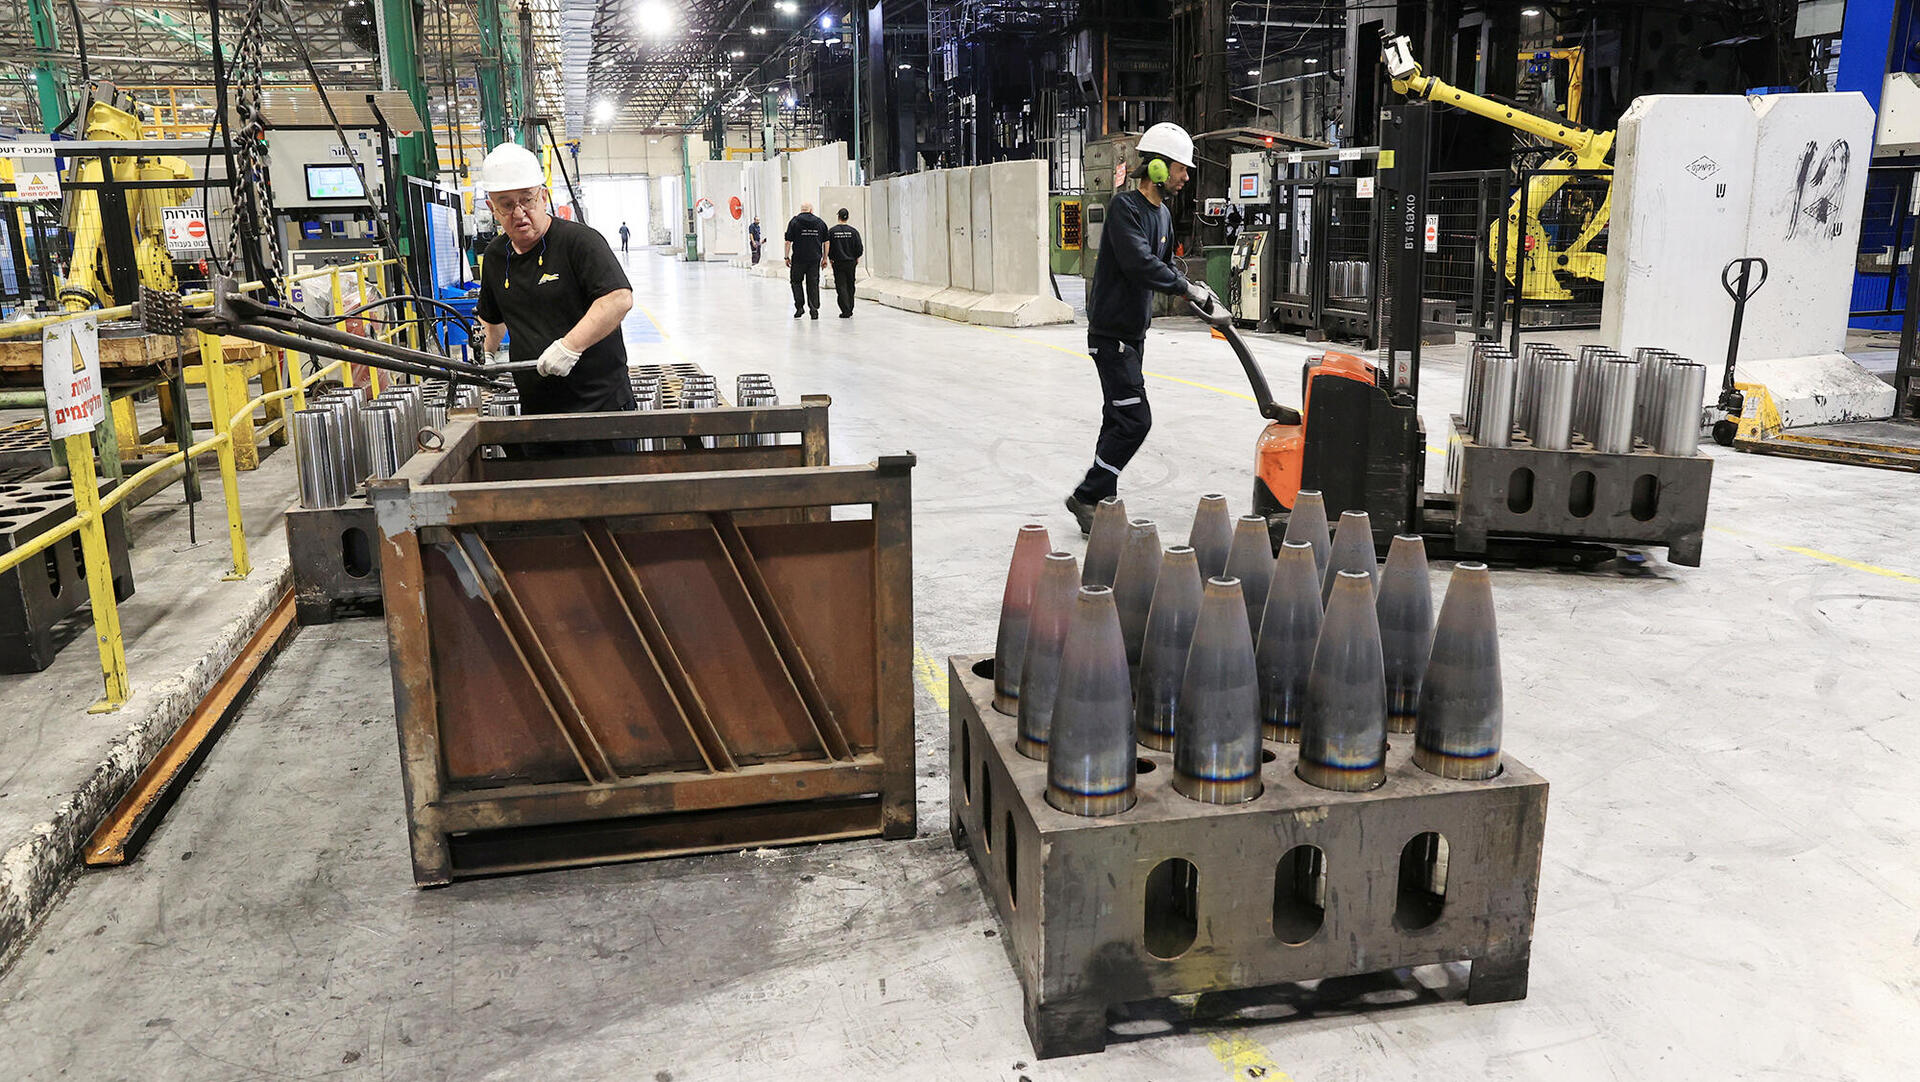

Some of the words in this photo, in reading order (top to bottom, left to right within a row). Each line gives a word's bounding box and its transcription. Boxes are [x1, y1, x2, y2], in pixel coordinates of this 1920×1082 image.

[164, 209, 204, 220] זהירות
[169, 241, 191, 249] בעבודה
[1405, 236, 1414, 249] BT
